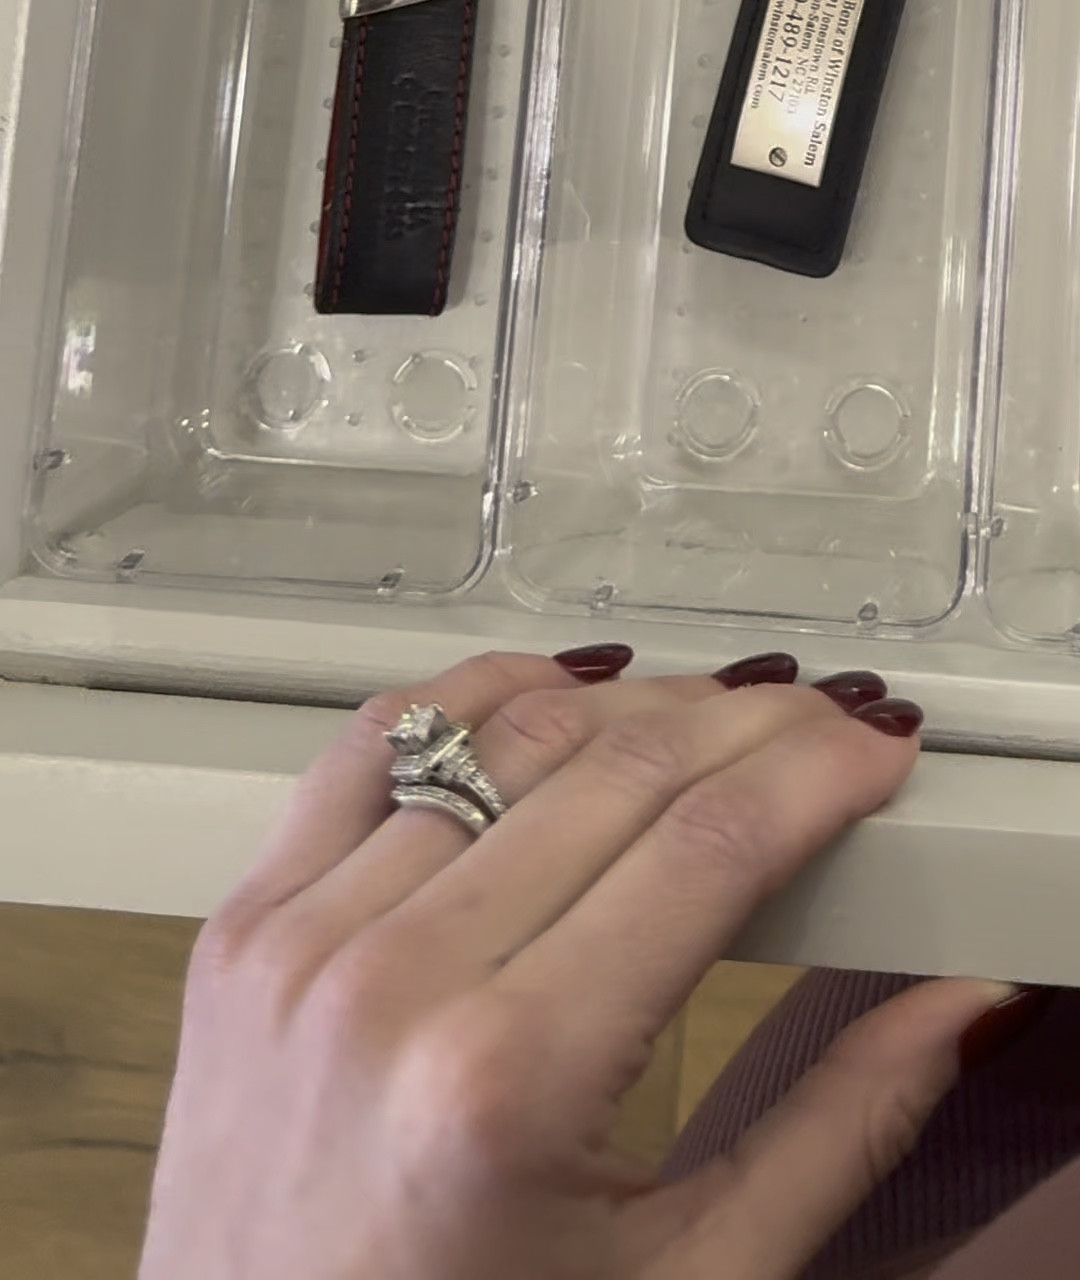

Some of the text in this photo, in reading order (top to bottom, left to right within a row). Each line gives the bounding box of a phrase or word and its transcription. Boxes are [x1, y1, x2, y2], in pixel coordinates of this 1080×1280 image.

[809, 10, 835, 73] Jonestown
[831, 40, 845, 56] of
[794, 56, 810, 77] NC
[816, 57, 843, 117] Winston
[803, 120, 827, 167] Salem
